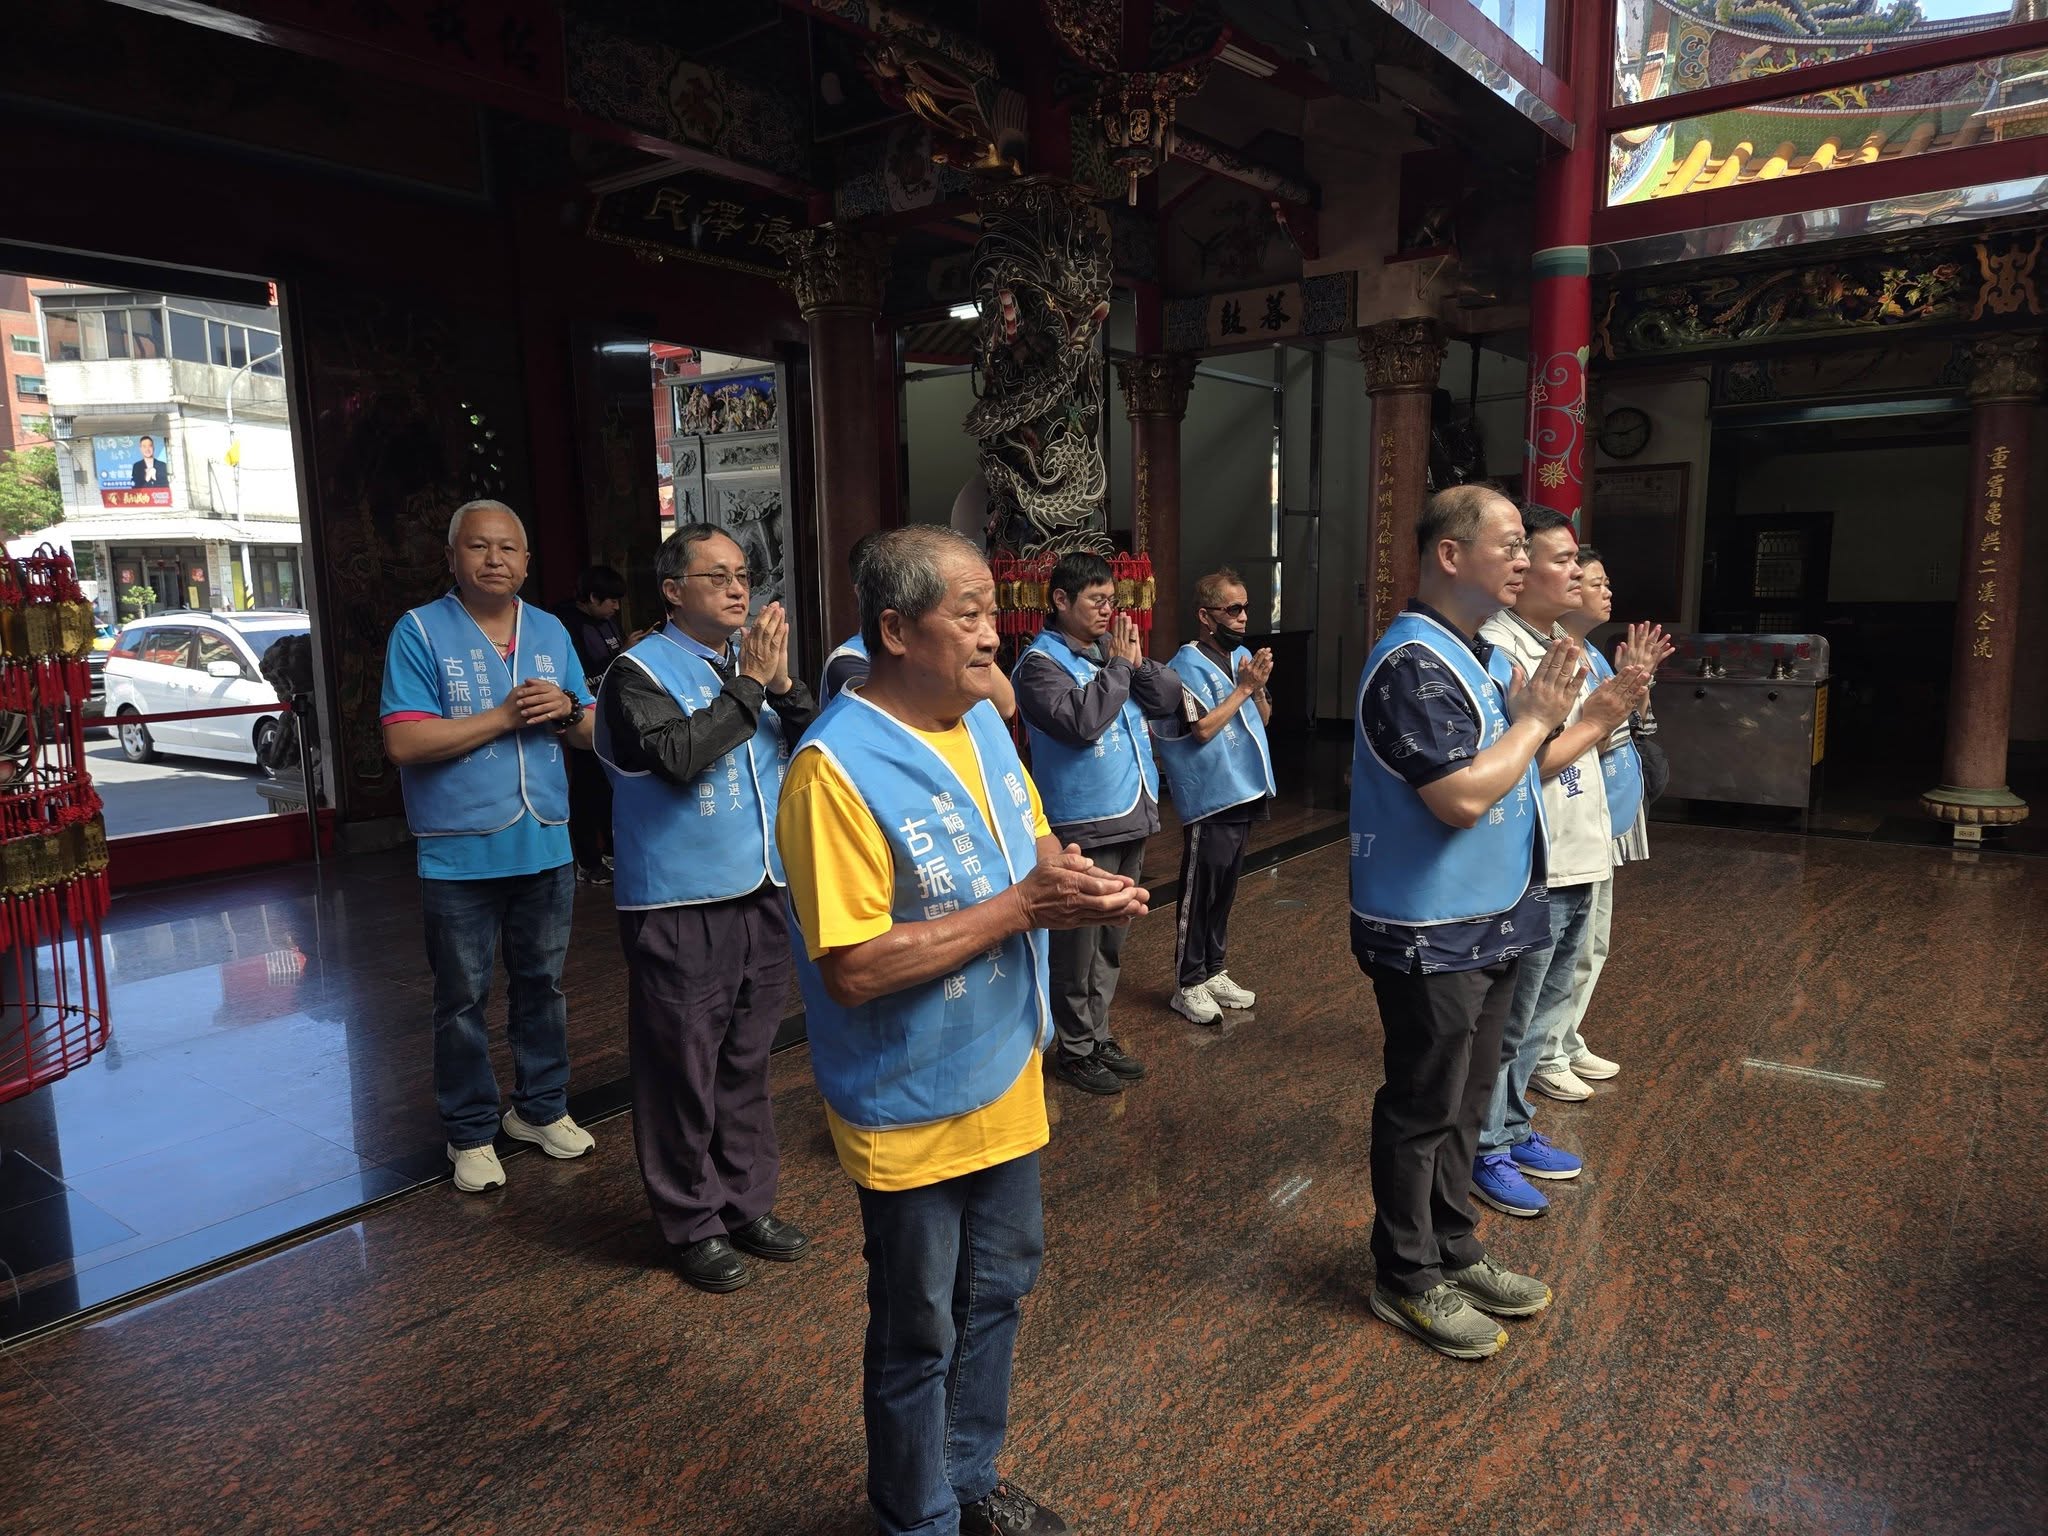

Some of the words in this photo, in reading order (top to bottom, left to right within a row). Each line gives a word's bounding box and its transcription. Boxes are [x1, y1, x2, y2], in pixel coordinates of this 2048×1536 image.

[931, 791, 994, 899] 楊梅區市議
